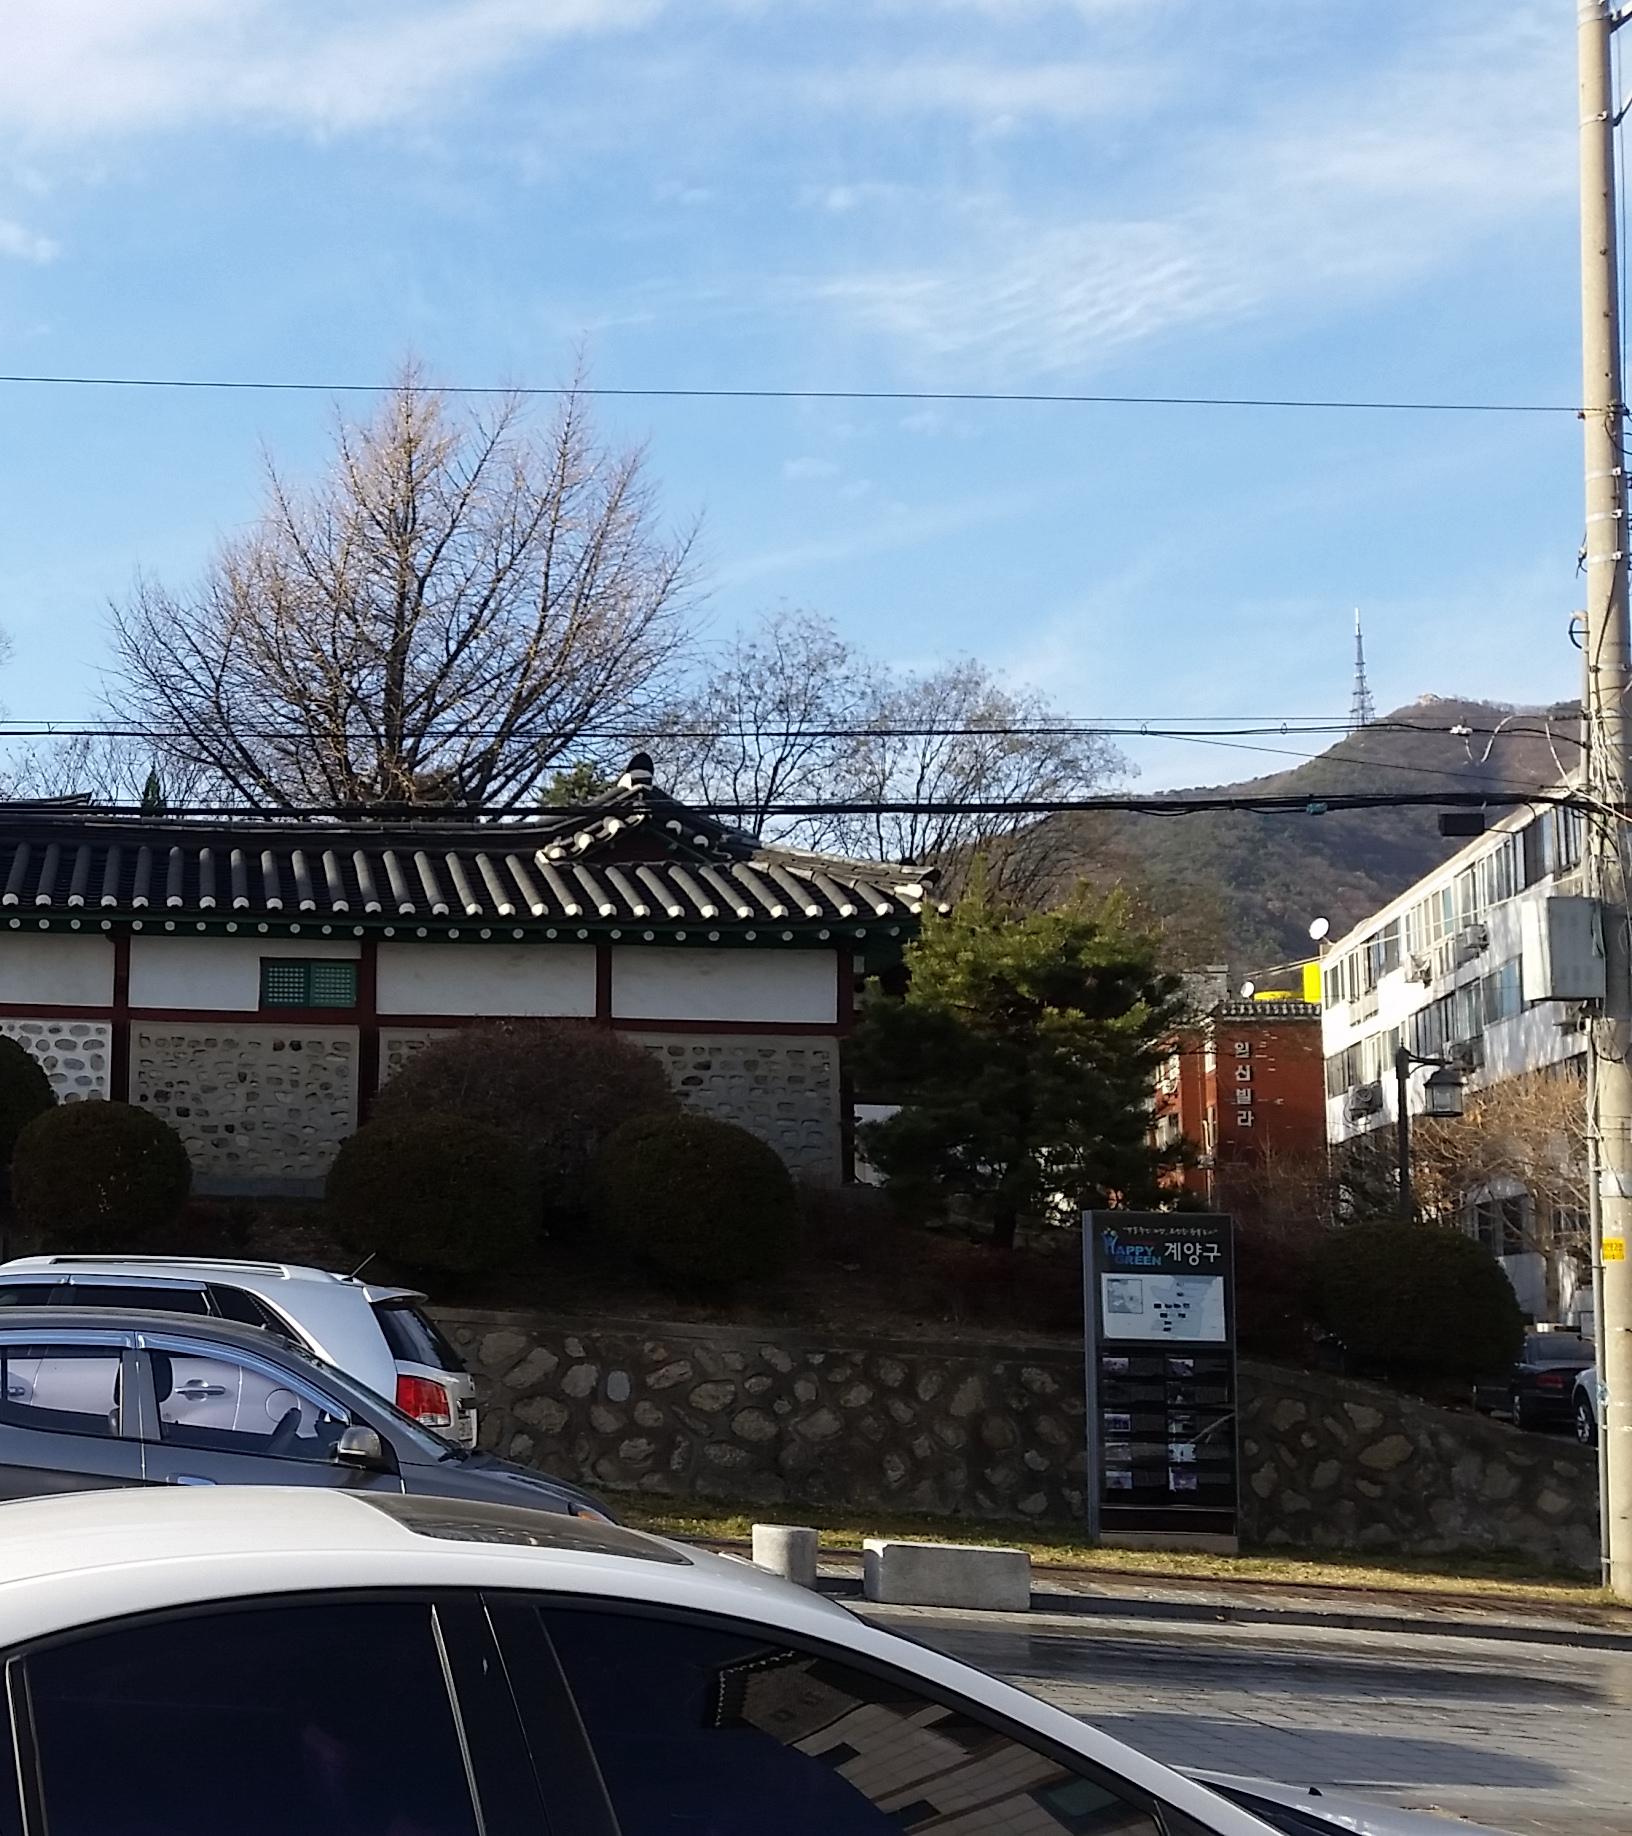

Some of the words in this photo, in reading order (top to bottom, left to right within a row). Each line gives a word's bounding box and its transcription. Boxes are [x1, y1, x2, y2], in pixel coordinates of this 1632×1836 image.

[1234, 1042, 1255, 1127] 일신빌라
[1102, 1233, 1154, 1255] HAPPY
[1164, 1242, 1222, 1266] 계양구
[1114, 1255, 1162, 1265] GREEN
